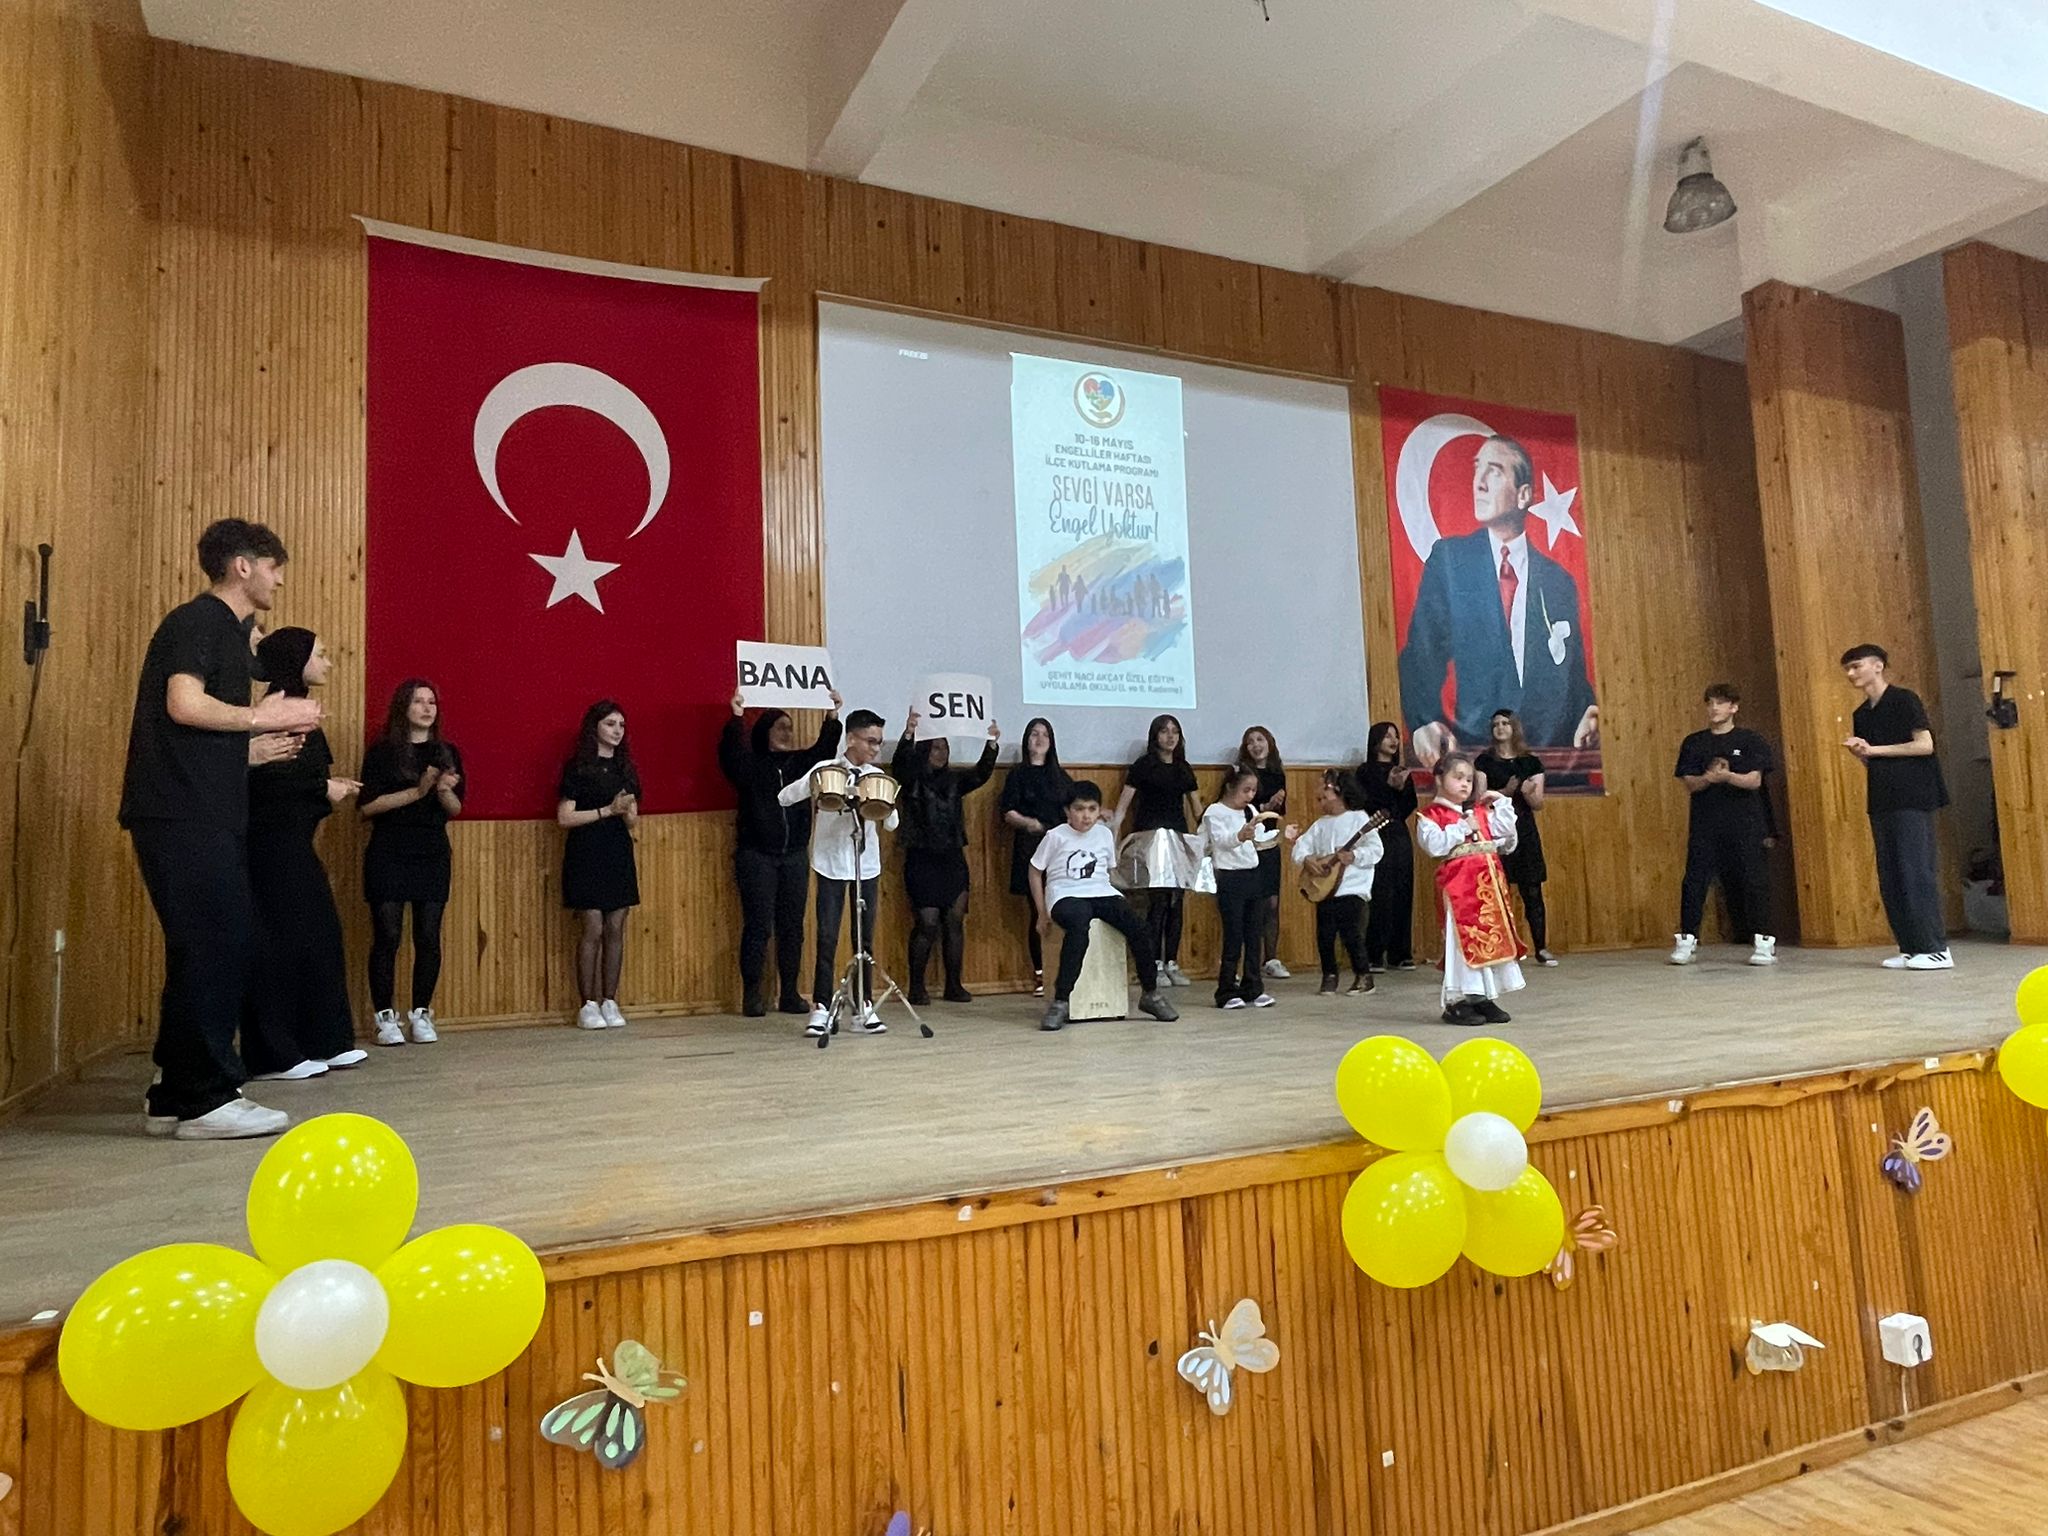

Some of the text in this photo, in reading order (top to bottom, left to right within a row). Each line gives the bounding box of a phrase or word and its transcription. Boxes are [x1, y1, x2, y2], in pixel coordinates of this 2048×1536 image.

[1055, 444, 1152, 465] ENGELLİLER HAFTASI
[1075, 433, 1134, 450] 10-16 MAYIS
[1045, 454, 1159, 478] İLÇE KUTLAMA PROGRAMI
[1052, 474, 1155, 510] SEVGİ VARSA
[1050, 499, 1159, 546] Engel Yoktur!
[739, 660, 832, 690] BANA
[928, 692, 985, 720] SEN
